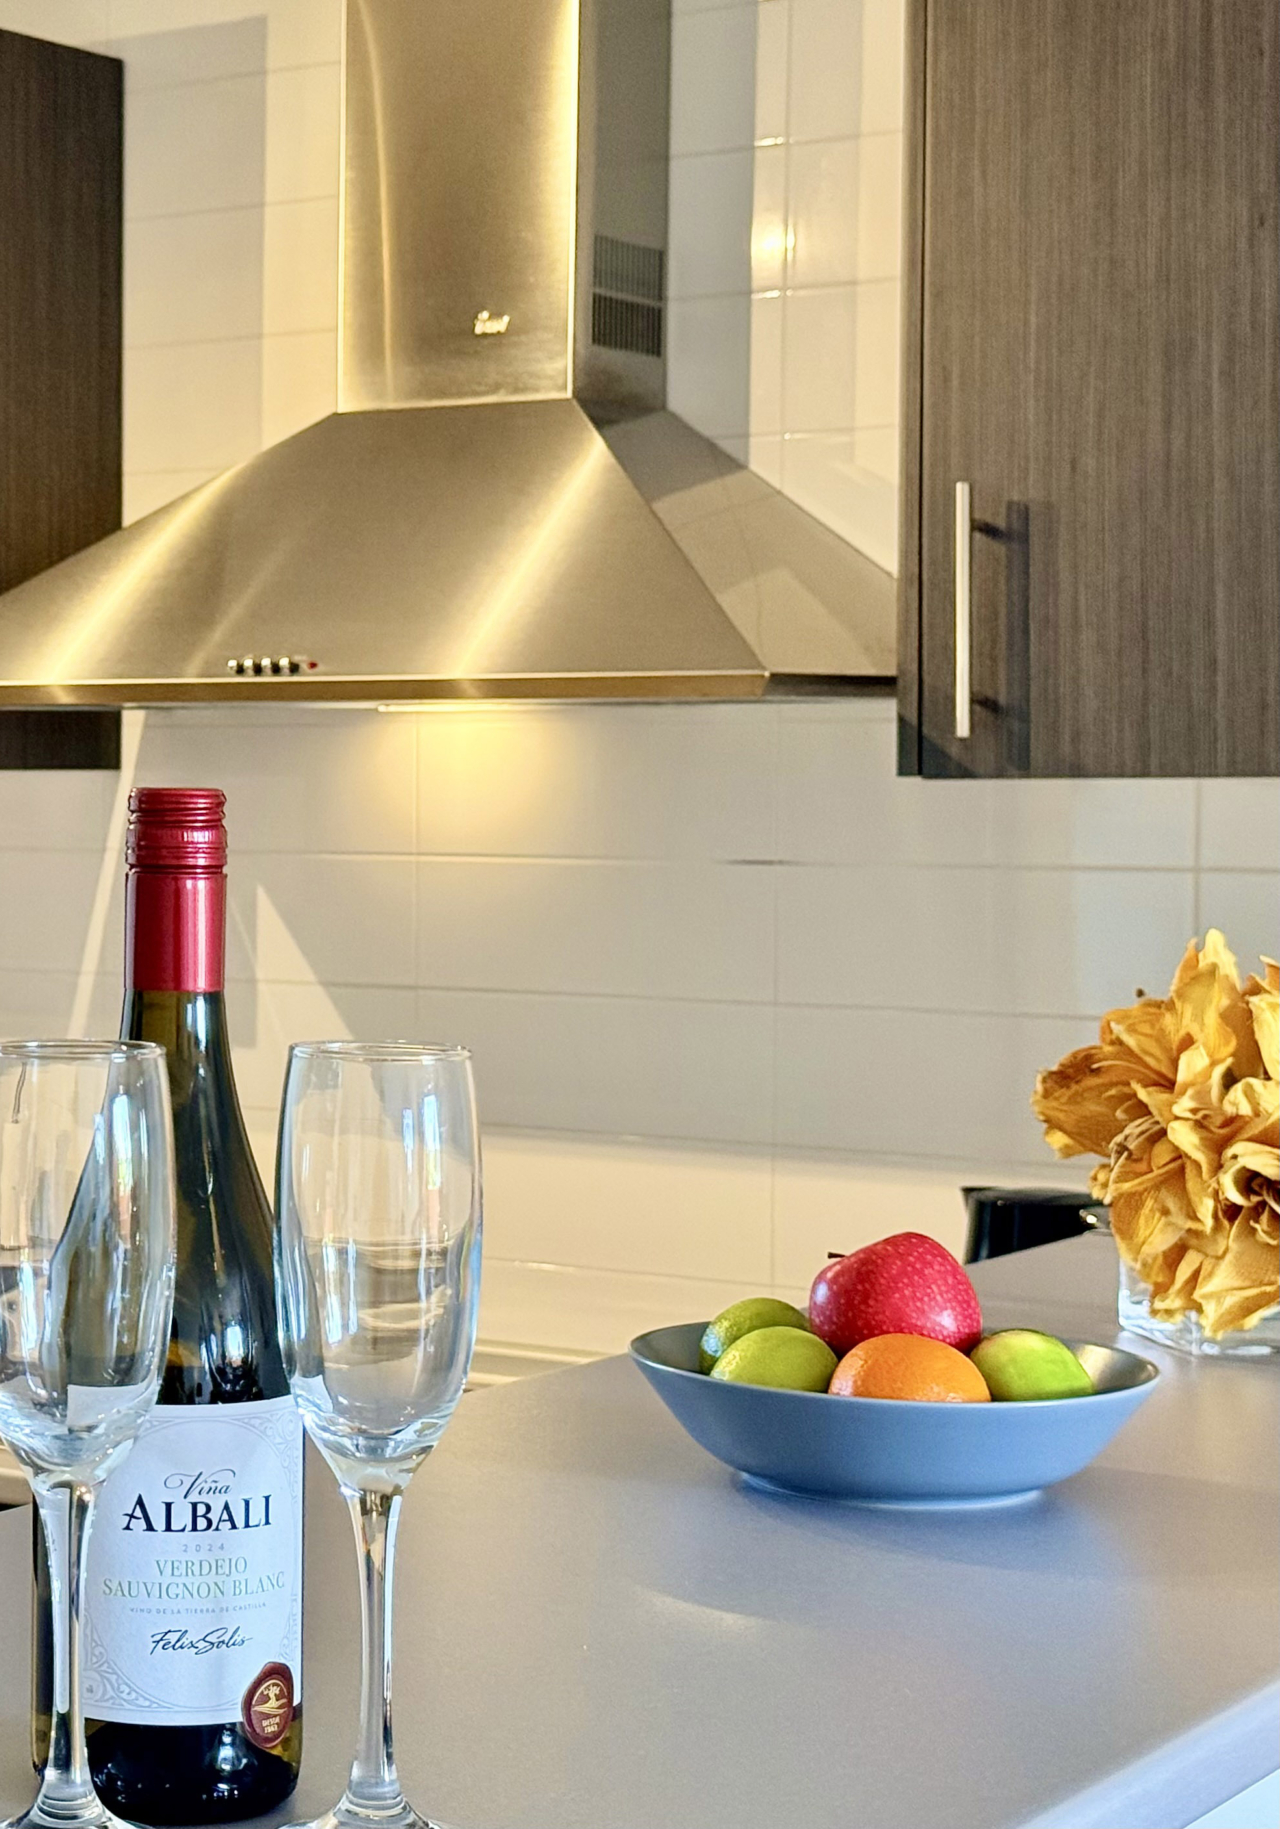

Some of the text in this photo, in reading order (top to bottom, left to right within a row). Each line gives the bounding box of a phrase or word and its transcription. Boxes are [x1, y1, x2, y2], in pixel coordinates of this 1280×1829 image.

[163, 1468, 236, 1500] Viña
[121, 1492, 272, 1533] ALBALI
[182, 1542, 225, 1553] 2024
[154, 1556, 248, 1578] VERDEJO
[102, 1570, 286, 1600] SAUVIGNON BLANC
[129, 1601, 267, 1615] VINO DE LA TIERRA DE CASTILLA
[150, 1628, 200, 1655] Felix
